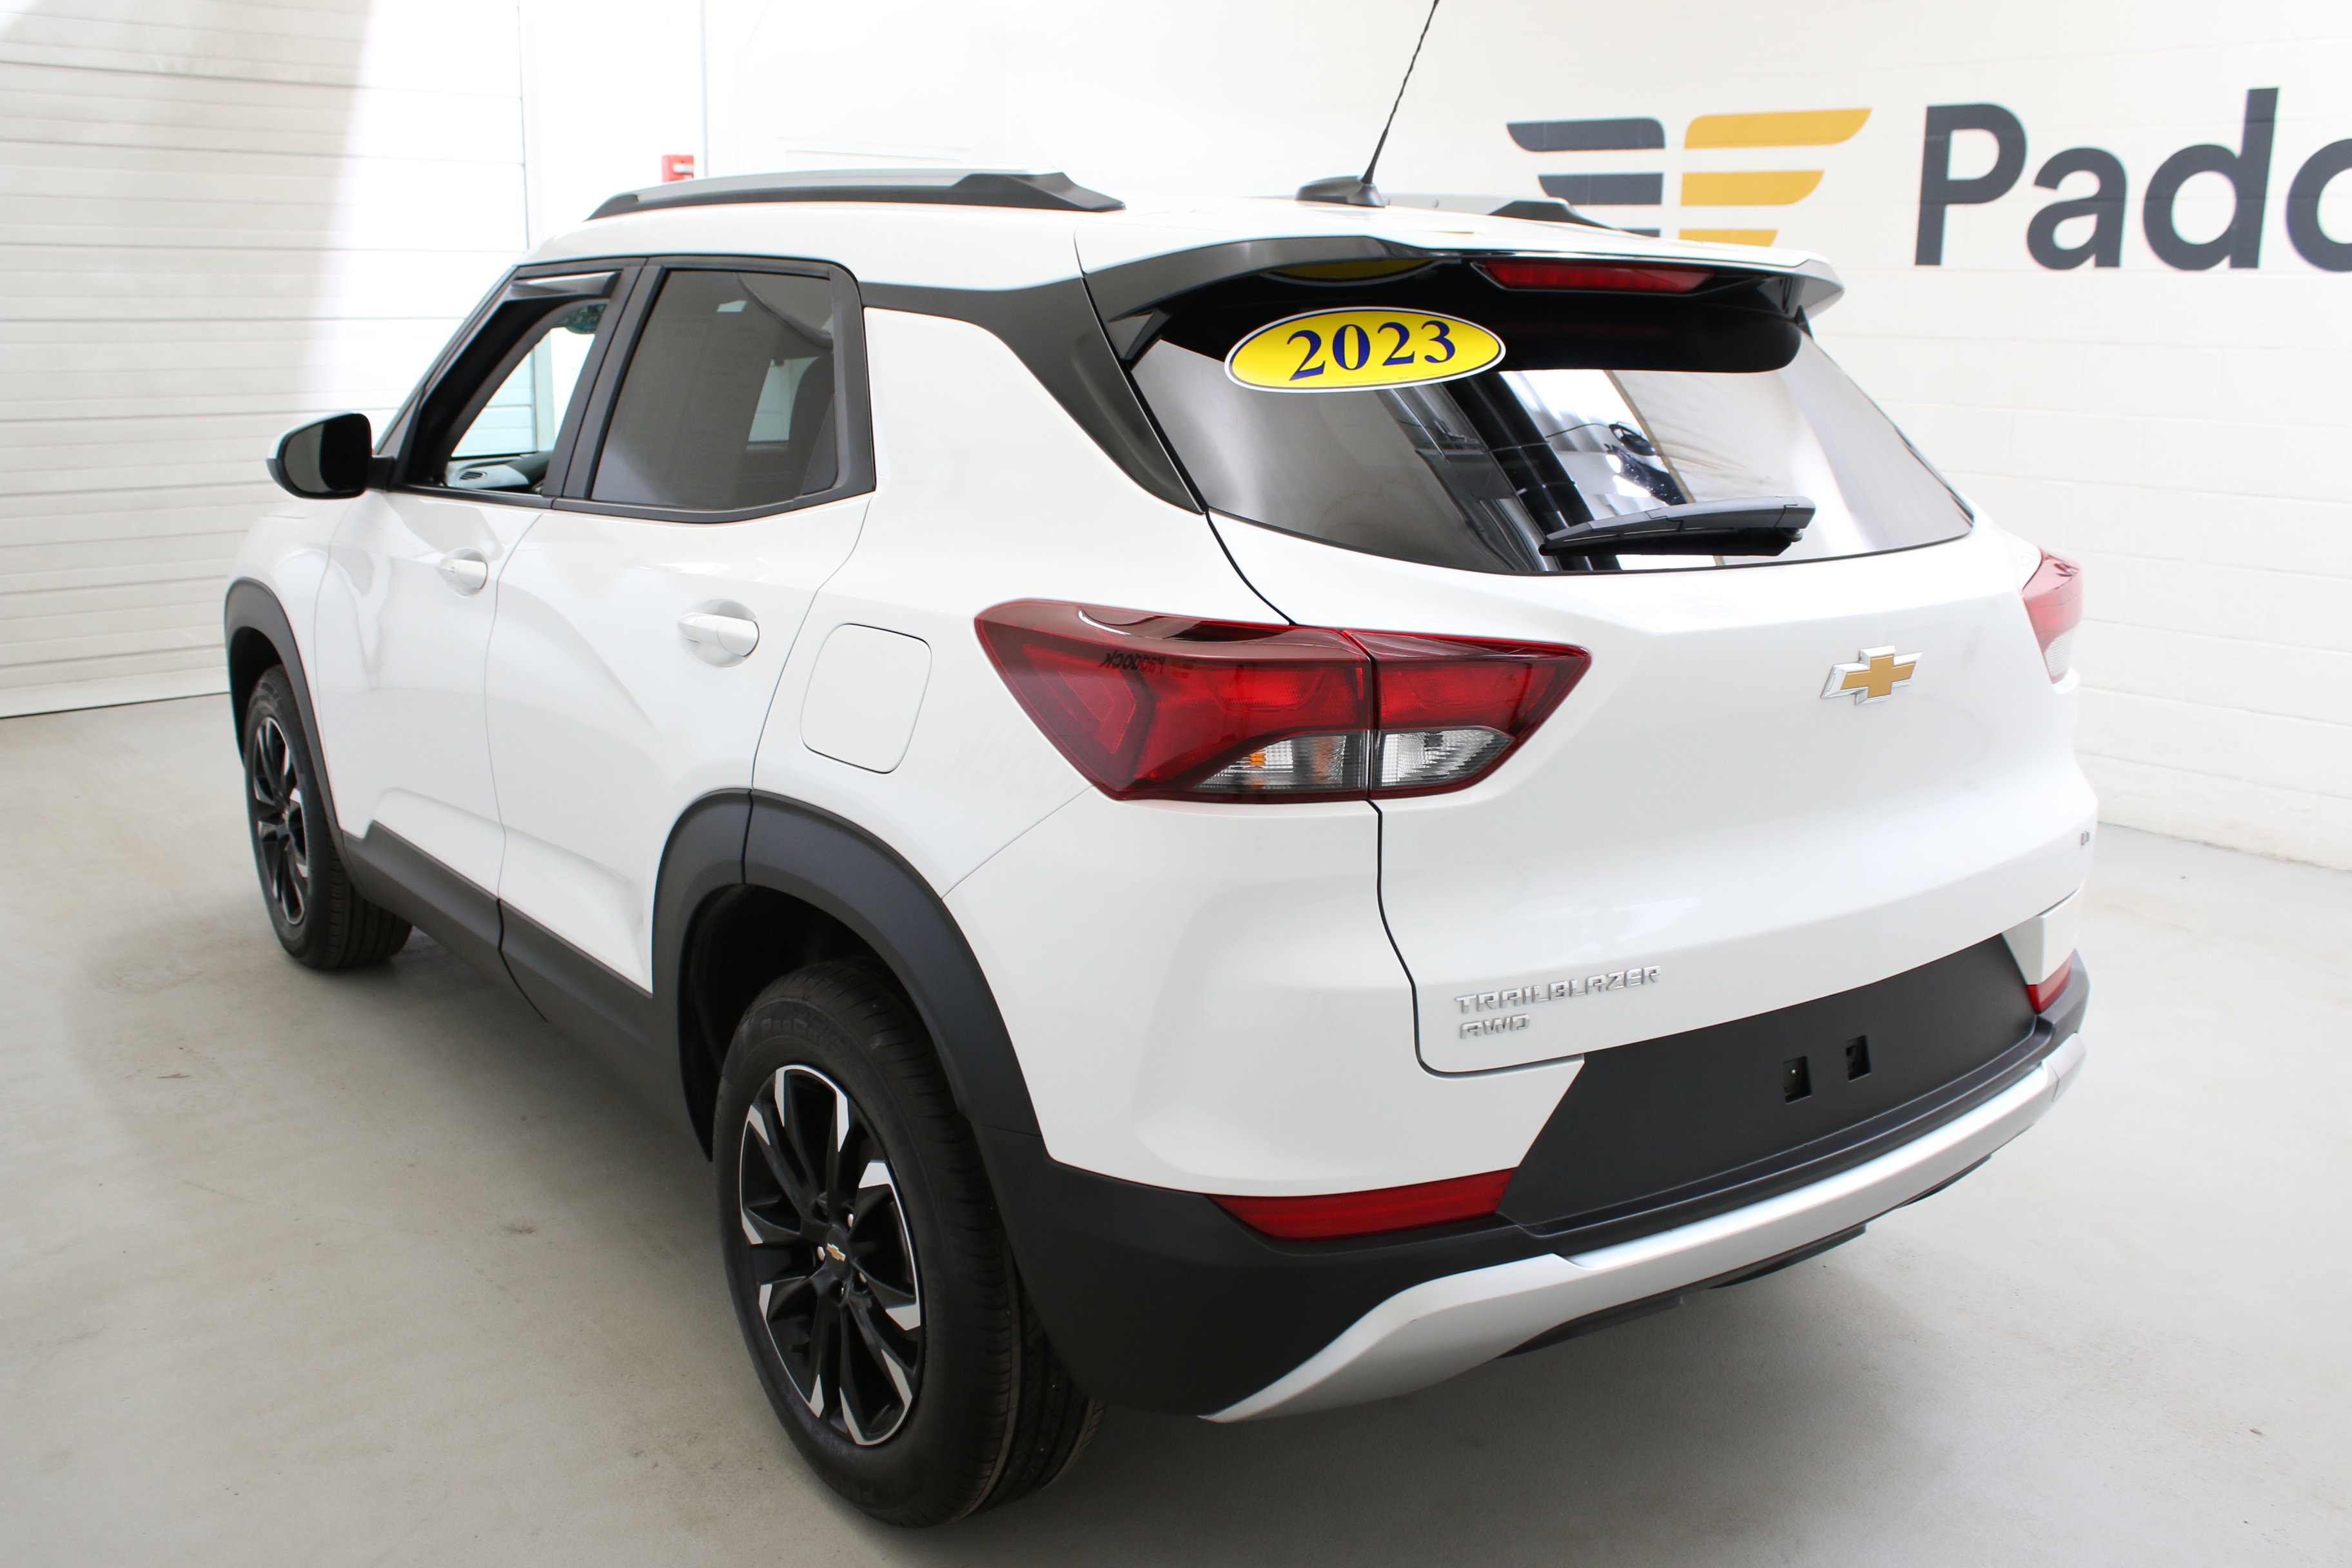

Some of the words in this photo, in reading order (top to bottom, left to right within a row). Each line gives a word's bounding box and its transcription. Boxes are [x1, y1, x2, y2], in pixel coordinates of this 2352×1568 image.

[1286, 320, 1456, 381] 2023
[1455, 965, 1661, 1014] TRAILBLAZER
[1459, 1013, 1531, 1040] AWD
